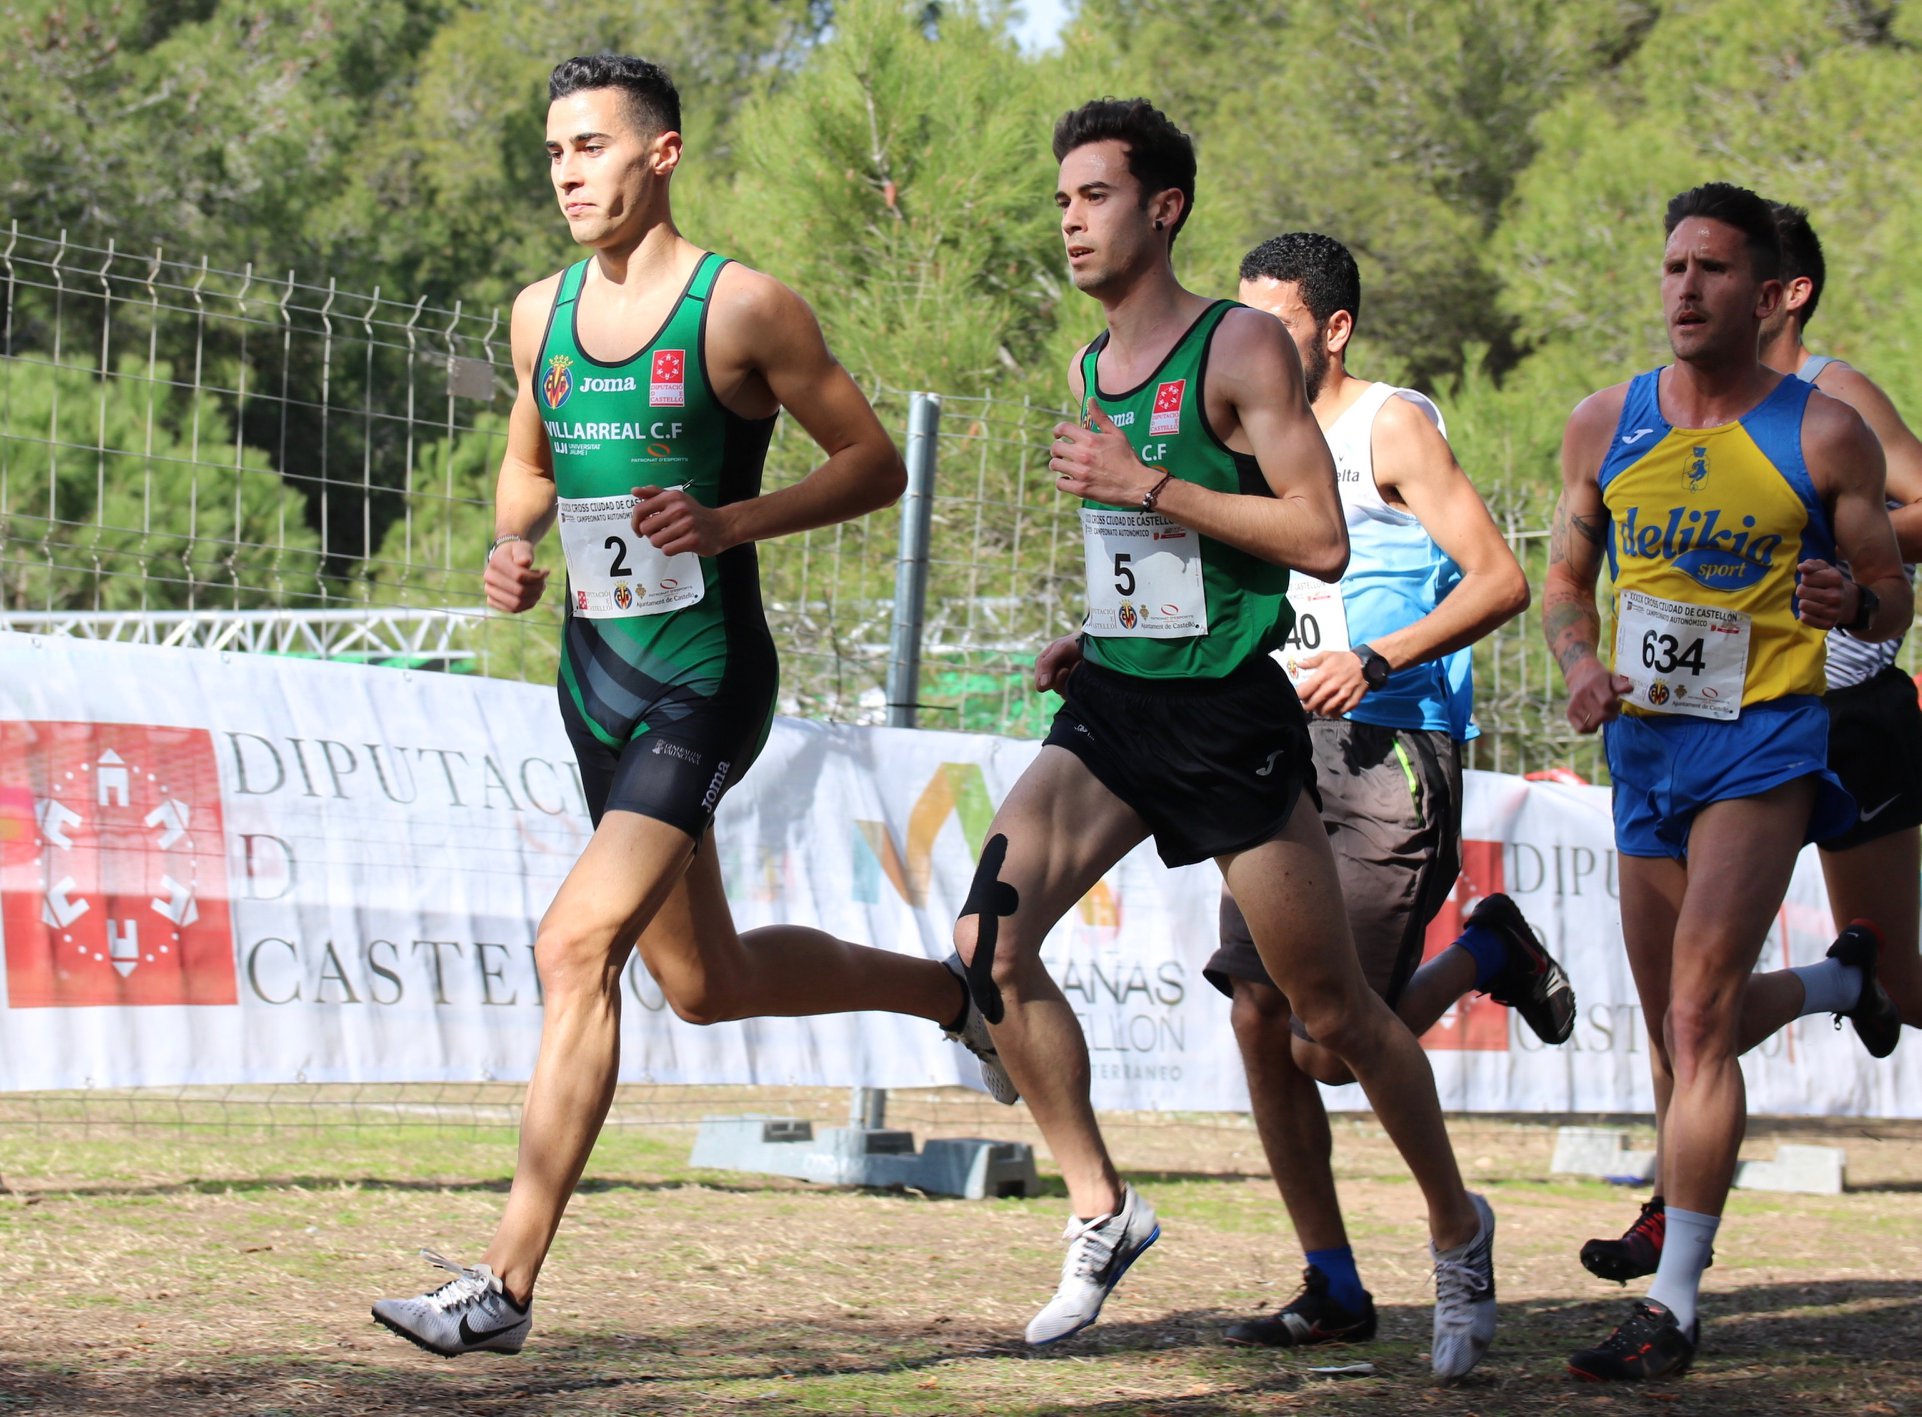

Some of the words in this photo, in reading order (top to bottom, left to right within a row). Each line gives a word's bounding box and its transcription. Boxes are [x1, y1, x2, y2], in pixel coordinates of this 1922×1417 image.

[579, 376, 637, 393] Joma
[1107, 411, 1135, 428] ma
[544, 420, 646, 440] VILLARREAL
[650, 422, 683, 440] C.F
[1141, 444, 1167, 461] C.F
[1337, 469, 1360, 483] elta
[571, 503, 590, 513] CROSS
[589, 500, 615, 512] CIUDAD
[615, 501, 625, 510] DE
[625, 499, 642, 509] CAS
[1105, 515, 1126, 526] CIUDAD
[1127, 516, 1136, 526] DE
[1620, 506, 1783, 567] delikia
[604, 535, 632, 578] 2
[1114, 553, 1136, 597] 5
[1698, 561, 1748, 580] sport
[665, 596, 673, 604] de
[1643, 595, 1659, 608] CROSS
[1659, 601, 1683, 614] CIUDAD
[1684, 606, 1695, 616] DE
[1696, 608, 1738, 622] CASTELLÓN
[1164, 622, 1172, 630] de
[1669, 615, 1708, 628] AUTONÓMICO
[1281, 613, 1321, 652] 40
[1642, 629, 1705, 677] 634
[223, 731, 590, 818] DIPUTACI
[701, 760, 731, 813] Joma
[238, 833, 298, 900] D
[1510, 842, 1620, 900] DIPU
